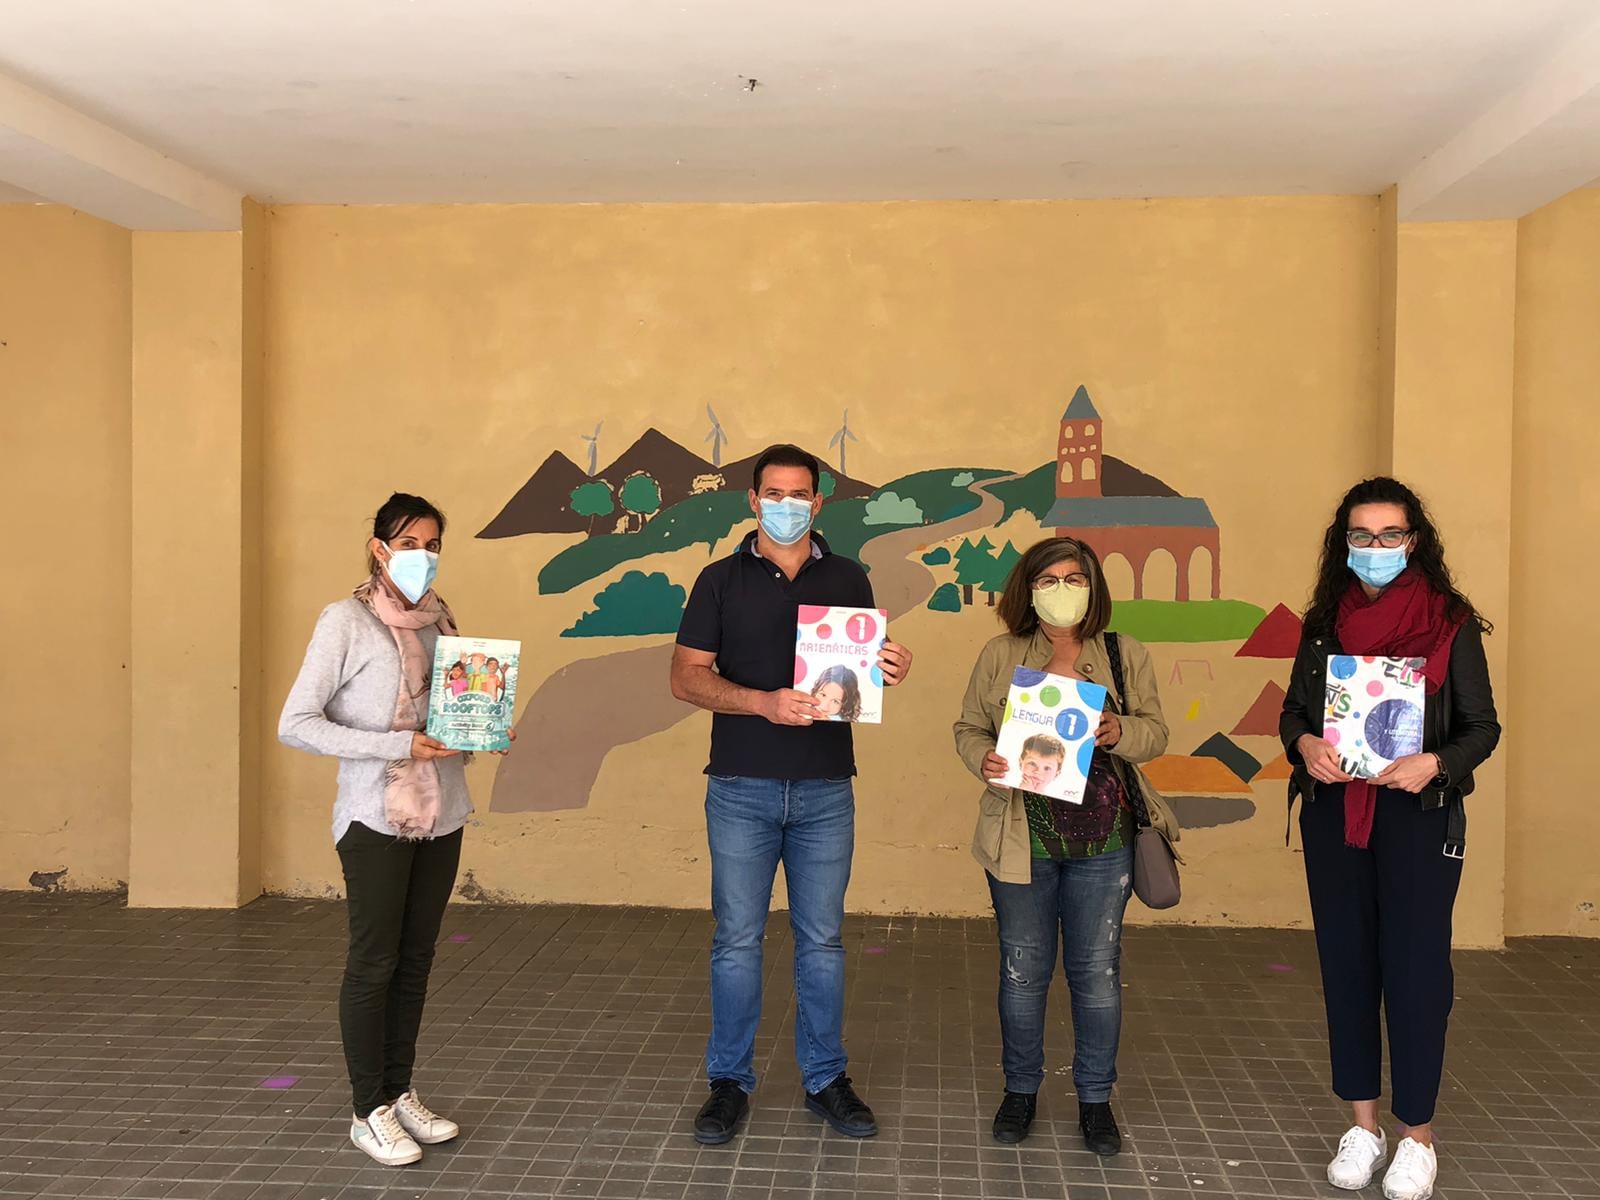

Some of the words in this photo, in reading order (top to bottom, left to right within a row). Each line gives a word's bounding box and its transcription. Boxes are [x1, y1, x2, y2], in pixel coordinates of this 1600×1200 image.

[855, 616, 867, 640] 1
[799, 642, 869, 656] MATEMÁTICAS
[457, 693, 491, 704] OXFORD
[443, 702, 502, 715] ROOFTOPS
[486, 722, 492, 730] 6
[1012, 707, 1054, 727] LENGUA
[1067, 713, 1078, 736] 1
